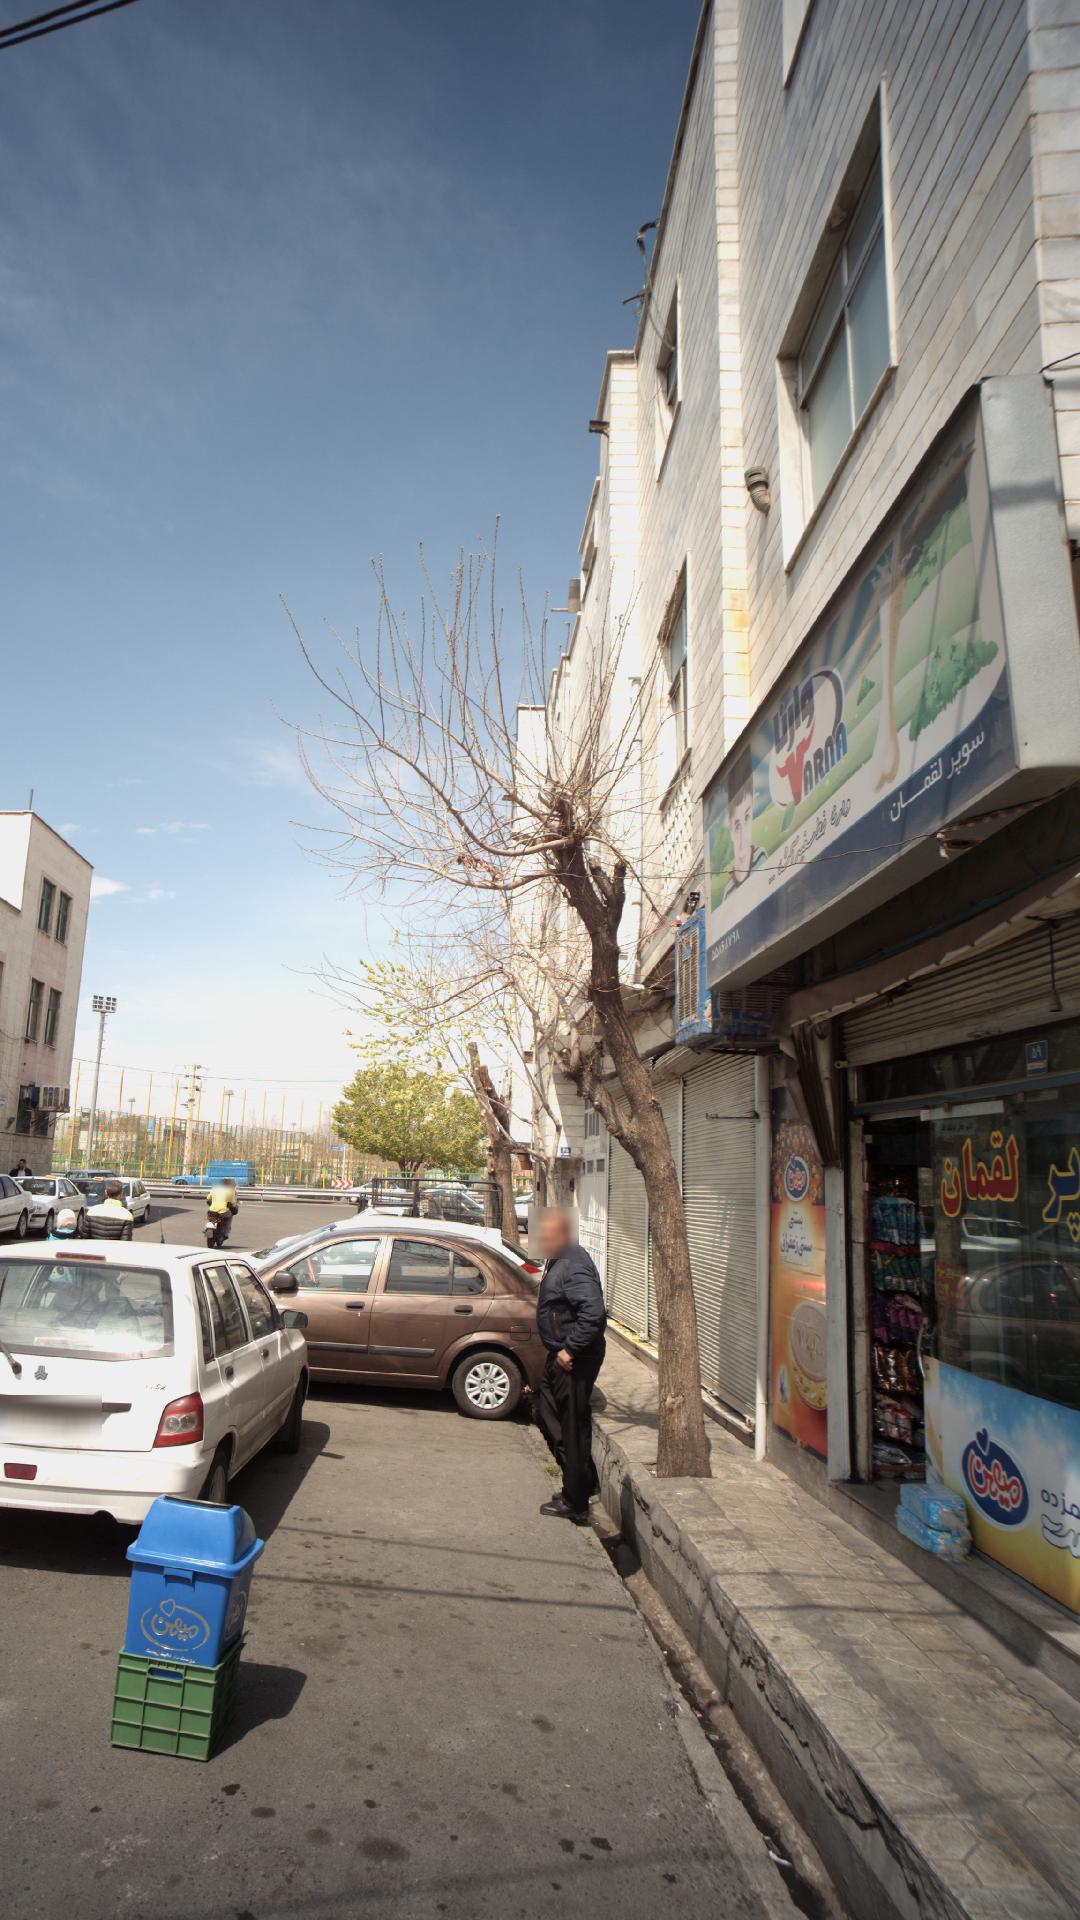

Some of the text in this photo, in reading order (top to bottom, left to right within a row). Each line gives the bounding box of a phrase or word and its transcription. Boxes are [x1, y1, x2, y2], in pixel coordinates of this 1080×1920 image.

[889, 731, 985, 822] سوپر لقمان
[940, 1130, 1019, 1217] لقمان
[969, 1450, 1023, 1511] میهن
[151, 1614, 199, 1641] میهن
